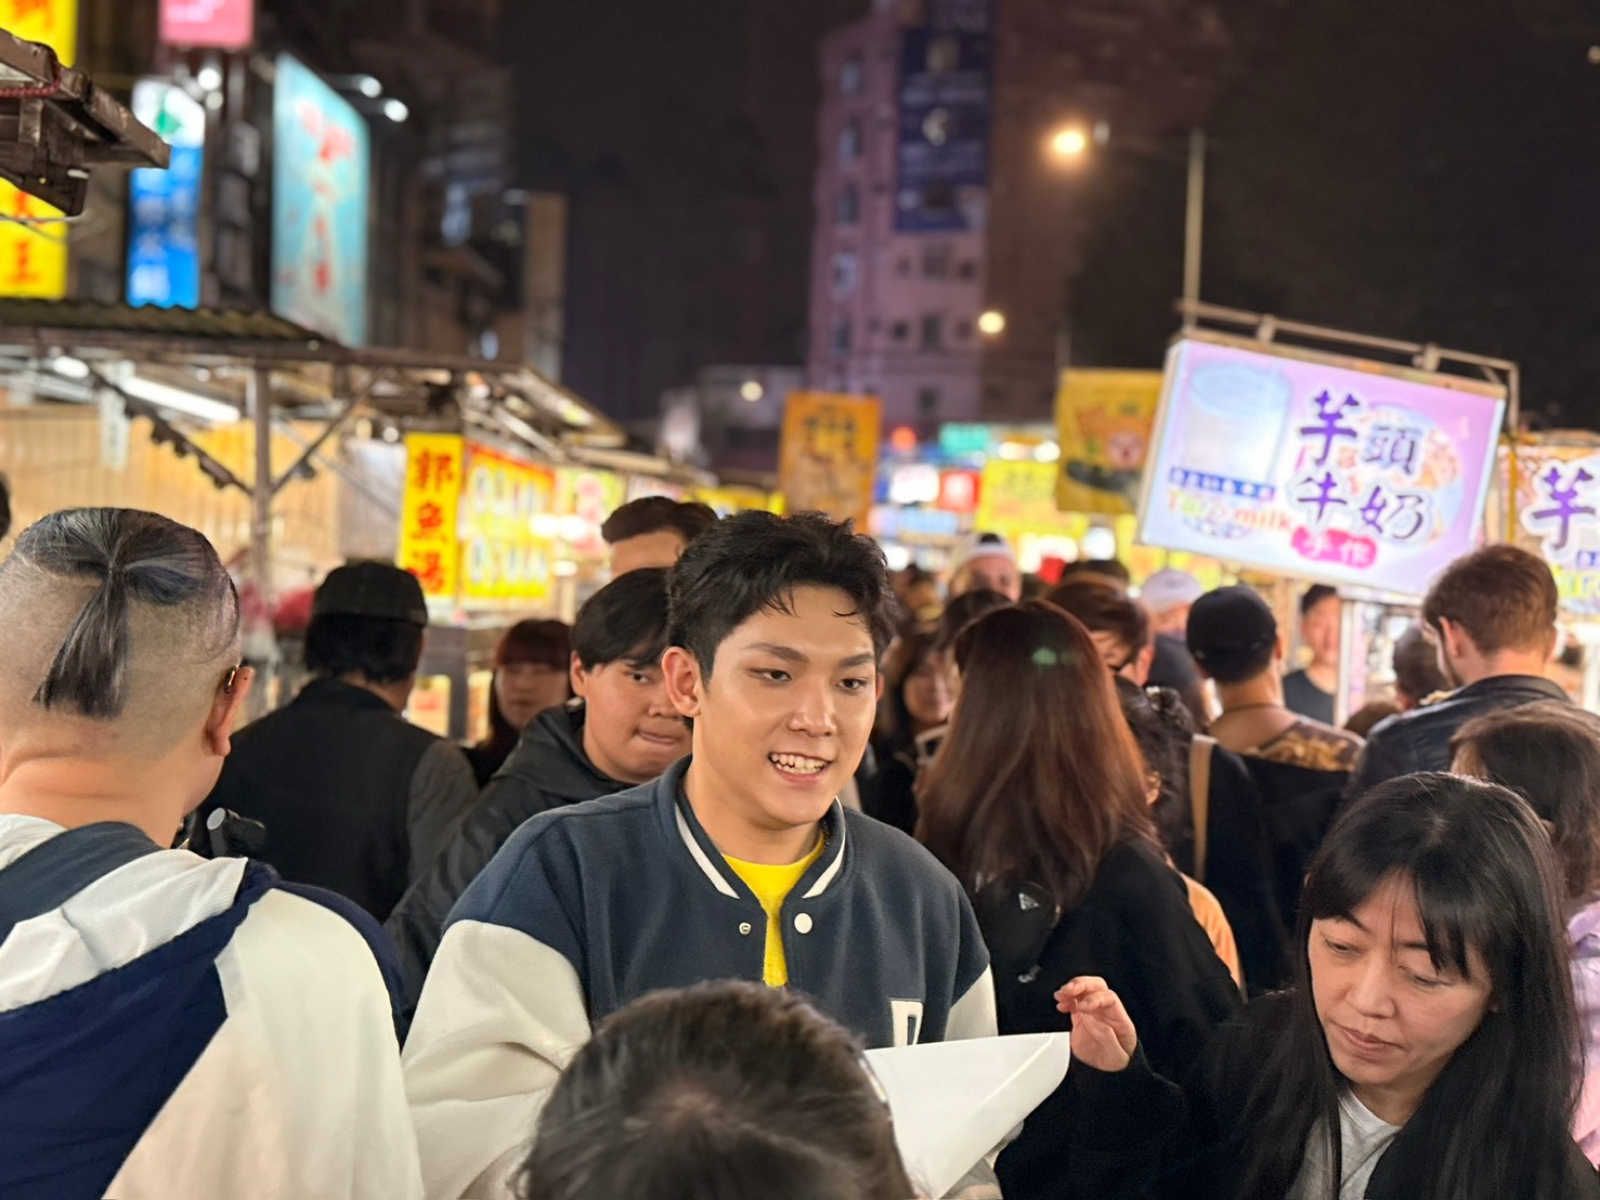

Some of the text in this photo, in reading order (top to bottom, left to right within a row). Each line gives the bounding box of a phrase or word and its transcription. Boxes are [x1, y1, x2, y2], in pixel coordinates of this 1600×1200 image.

[1298, 389, 1424, 476] 芋頭
[1234, 508, 1293, 535] milk
[1297, 471, 1425, 541] 牛奶
[1532, 466, 1597, 551] 芋
